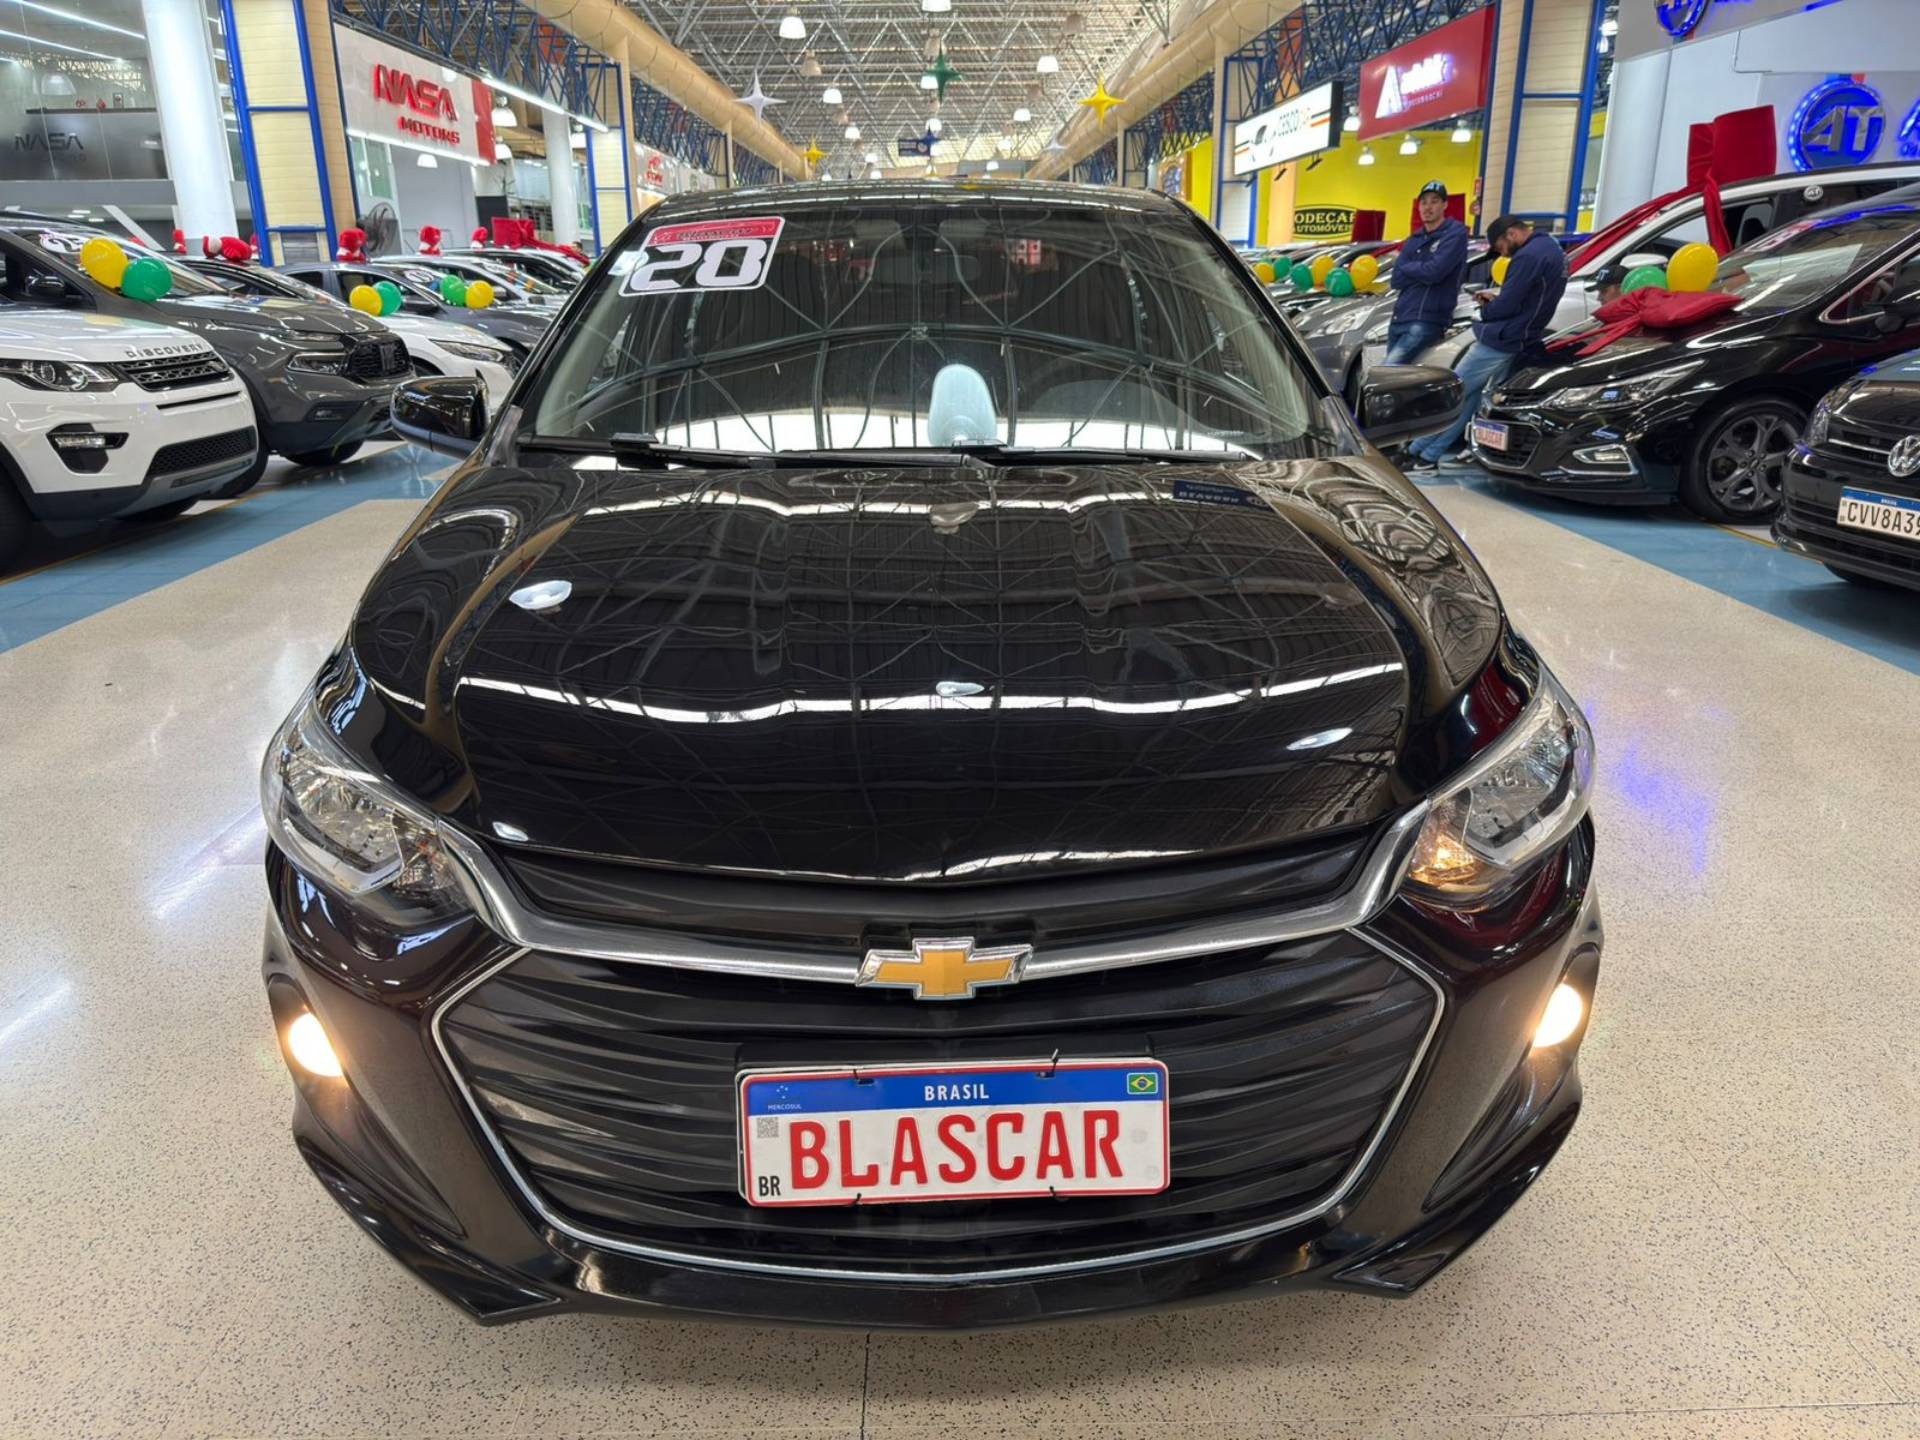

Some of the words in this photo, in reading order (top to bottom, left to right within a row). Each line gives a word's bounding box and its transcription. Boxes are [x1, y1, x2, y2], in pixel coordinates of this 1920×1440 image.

[373, 63, 458, 122] NASA
[397, 116, 460, 144] MOTORS
[1804, 105, 1883, 152] AT
[629, 239, 767, 291] 20
[125, 343, 204, 358] DISCOVERY
[924, 1084, 990, 1101] BRASIL
[789, 1109, 1123, 1190] BLASCAR
[758, 1175, 781, 1197] BR
